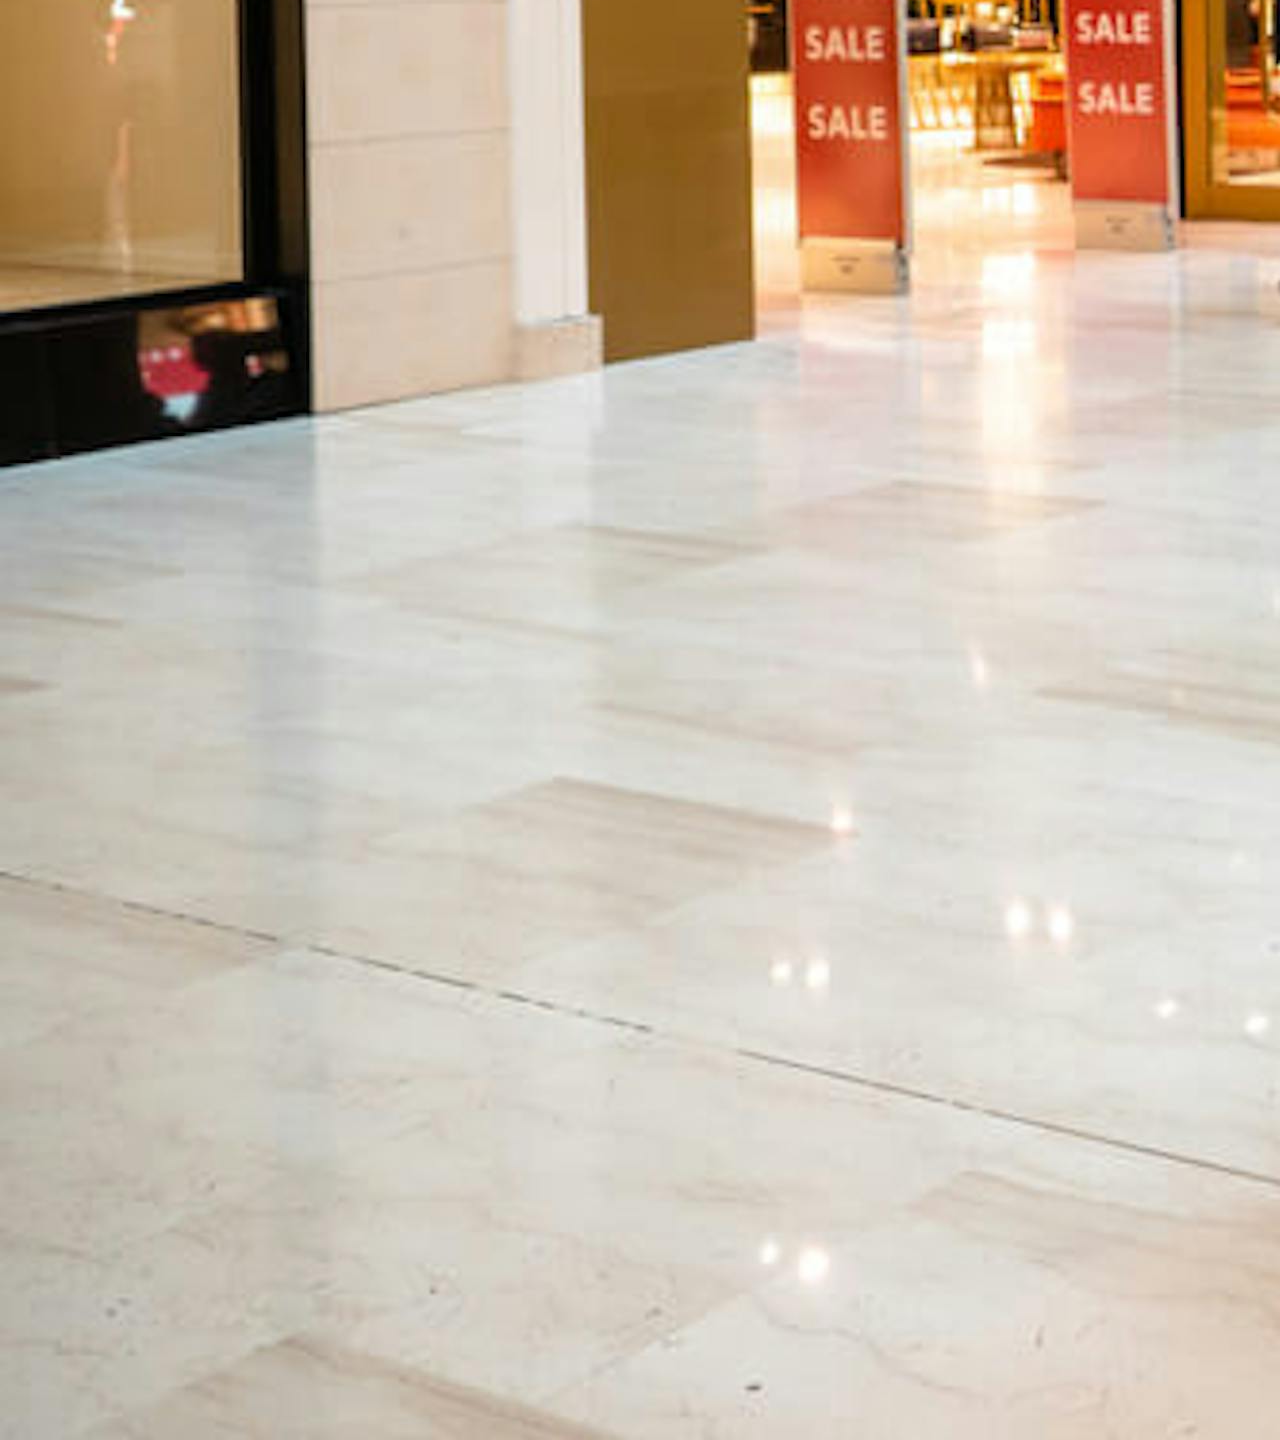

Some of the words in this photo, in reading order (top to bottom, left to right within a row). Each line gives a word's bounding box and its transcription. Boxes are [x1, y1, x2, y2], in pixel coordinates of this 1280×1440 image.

[804, 26, 885, 62] SALE
[1075, 11, 1152, 46] SALE
[1077, 81, 1155, 116] SALE
[808, 103, 888, 140] SALE
